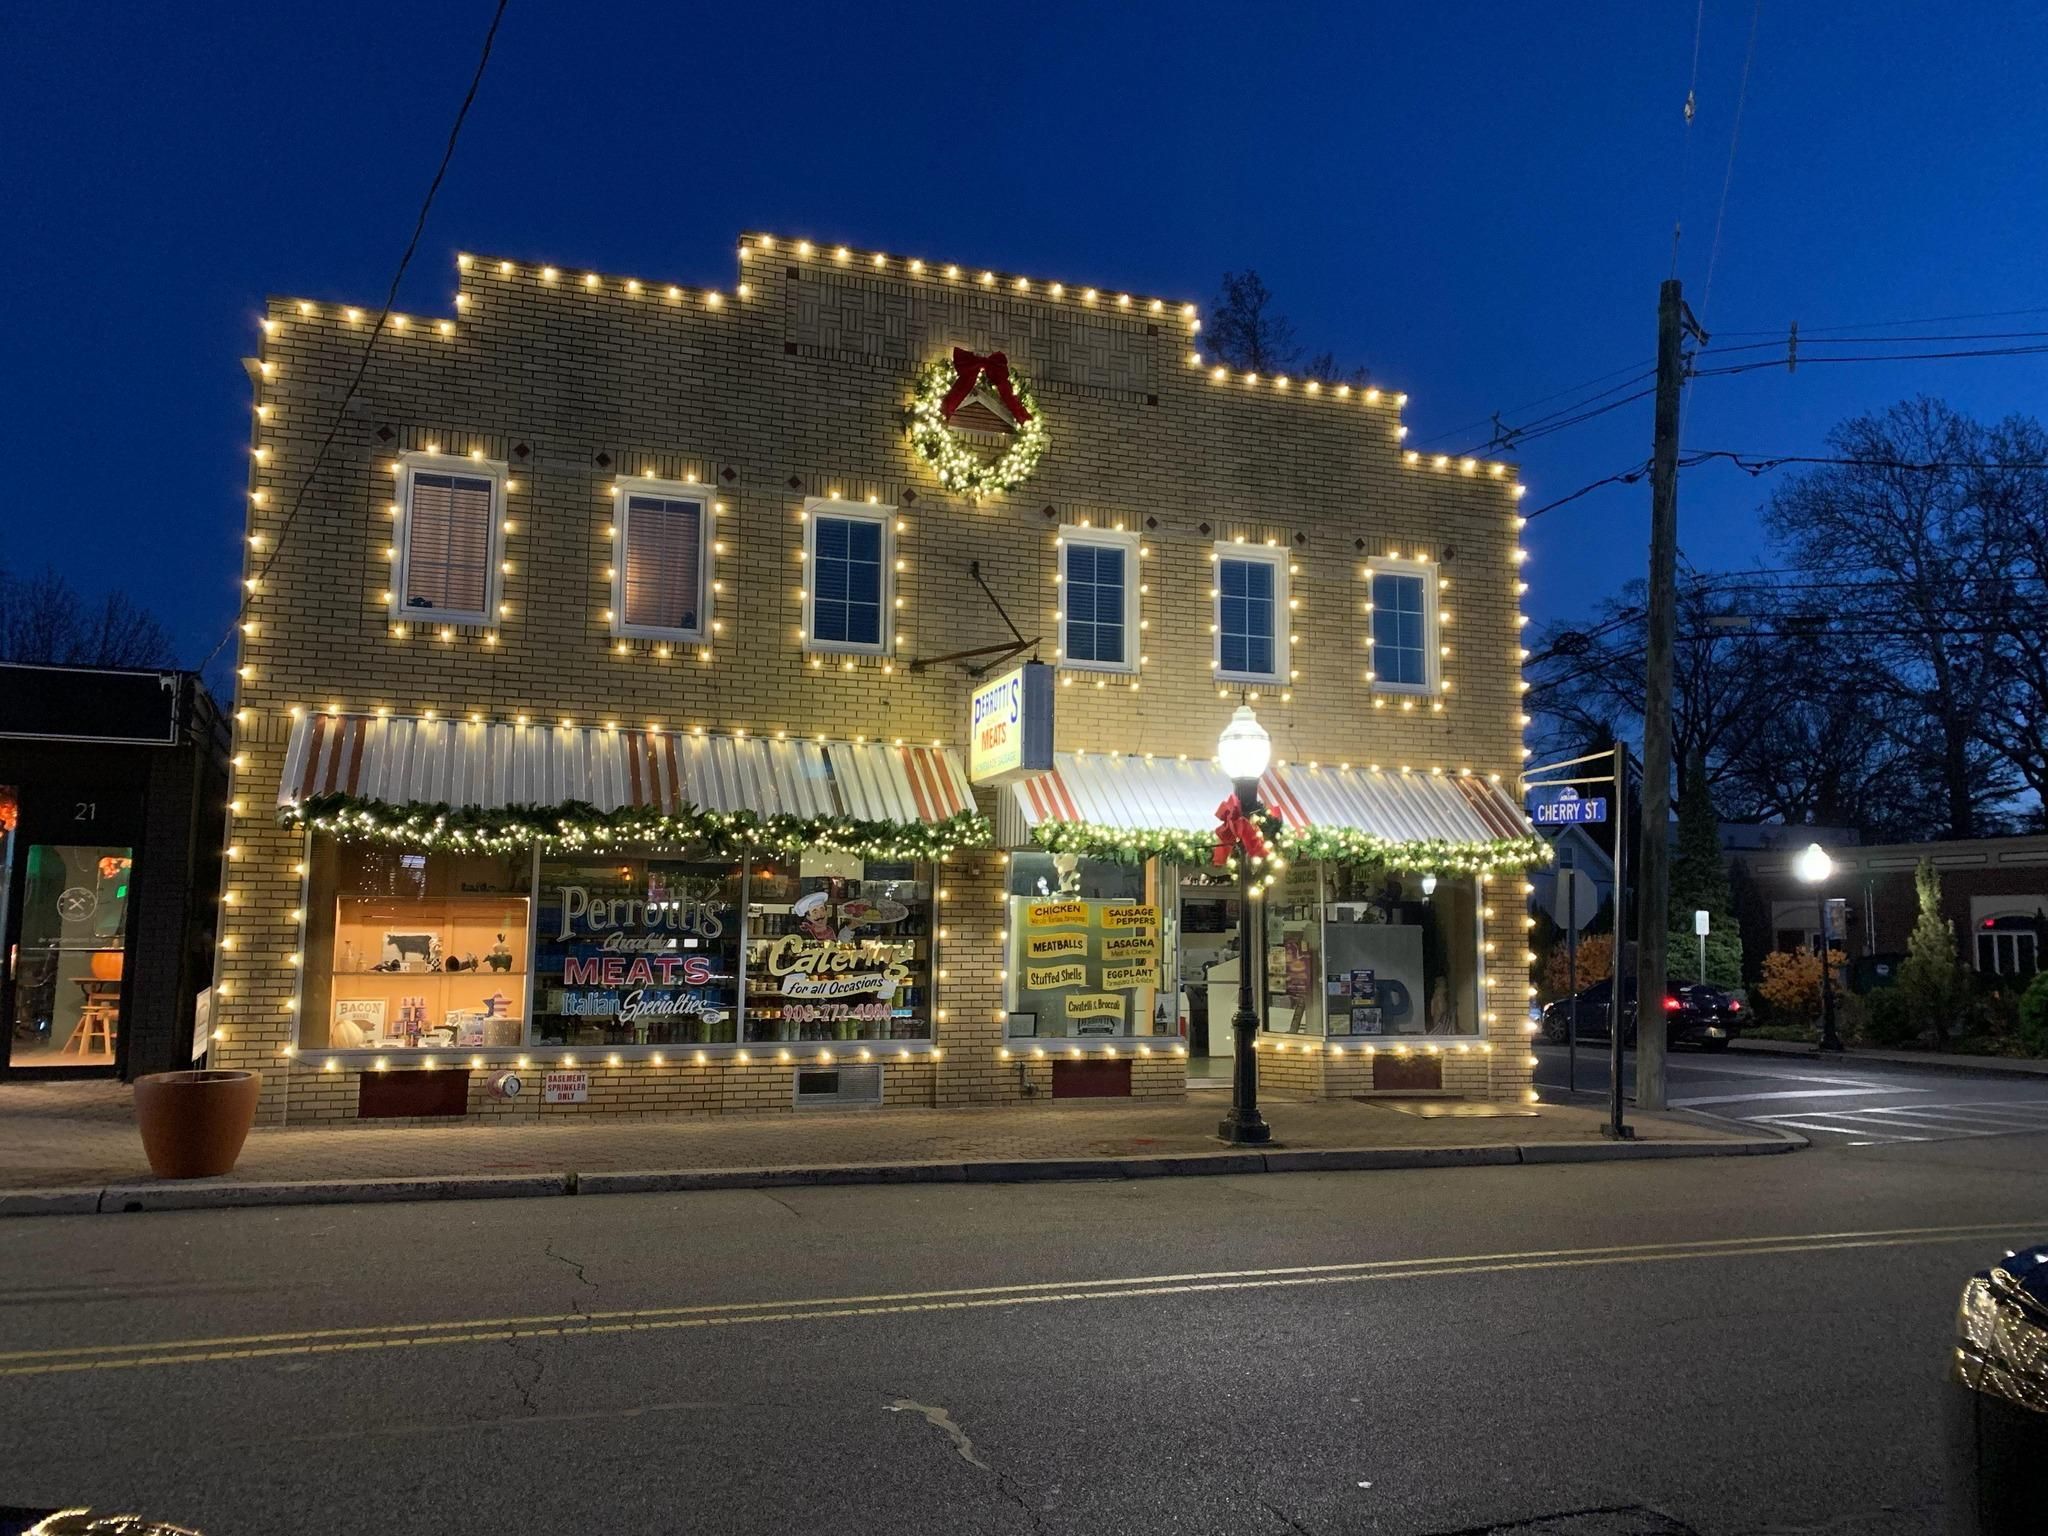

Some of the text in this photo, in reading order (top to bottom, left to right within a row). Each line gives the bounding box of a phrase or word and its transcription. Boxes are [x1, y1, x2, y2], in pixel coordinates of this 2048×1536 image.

[981, 722, 1006, 752] MEATS
[74, 802, 96, 821] 21
[1538, 801, 1601, 821] CHERRY ST.
[556, 885, 723, 943] Perrotti's
[1034, 904, 1081, 916] CHICKEN
[1109, 908, 1154, 917] SAUSAGE
[1116, 917, 1156, 925] PEPPERS
[1033, 939, 1083, 952] MEATBALLS
[1107, 939, 1155, 949] LASAGNA
[768, 934, 916, 981] Catering
[563, 957, 711, 985] MEATS
[1030, 968, 1082, 985] Stuffed Shells
[1107, 968, 1154, 979] EGGPLANT
[787, 977, 884, 995] for all Occasions
[339, 1003, 382, 1015] BACON
[561, 989, 708, 1025] Italian Specialties
[548, 1074, 585, 1082] BASEMENT
[547, 1083, 586, 1091] SPRINKLER
[557, 1092, 575, 1100] ONLY
